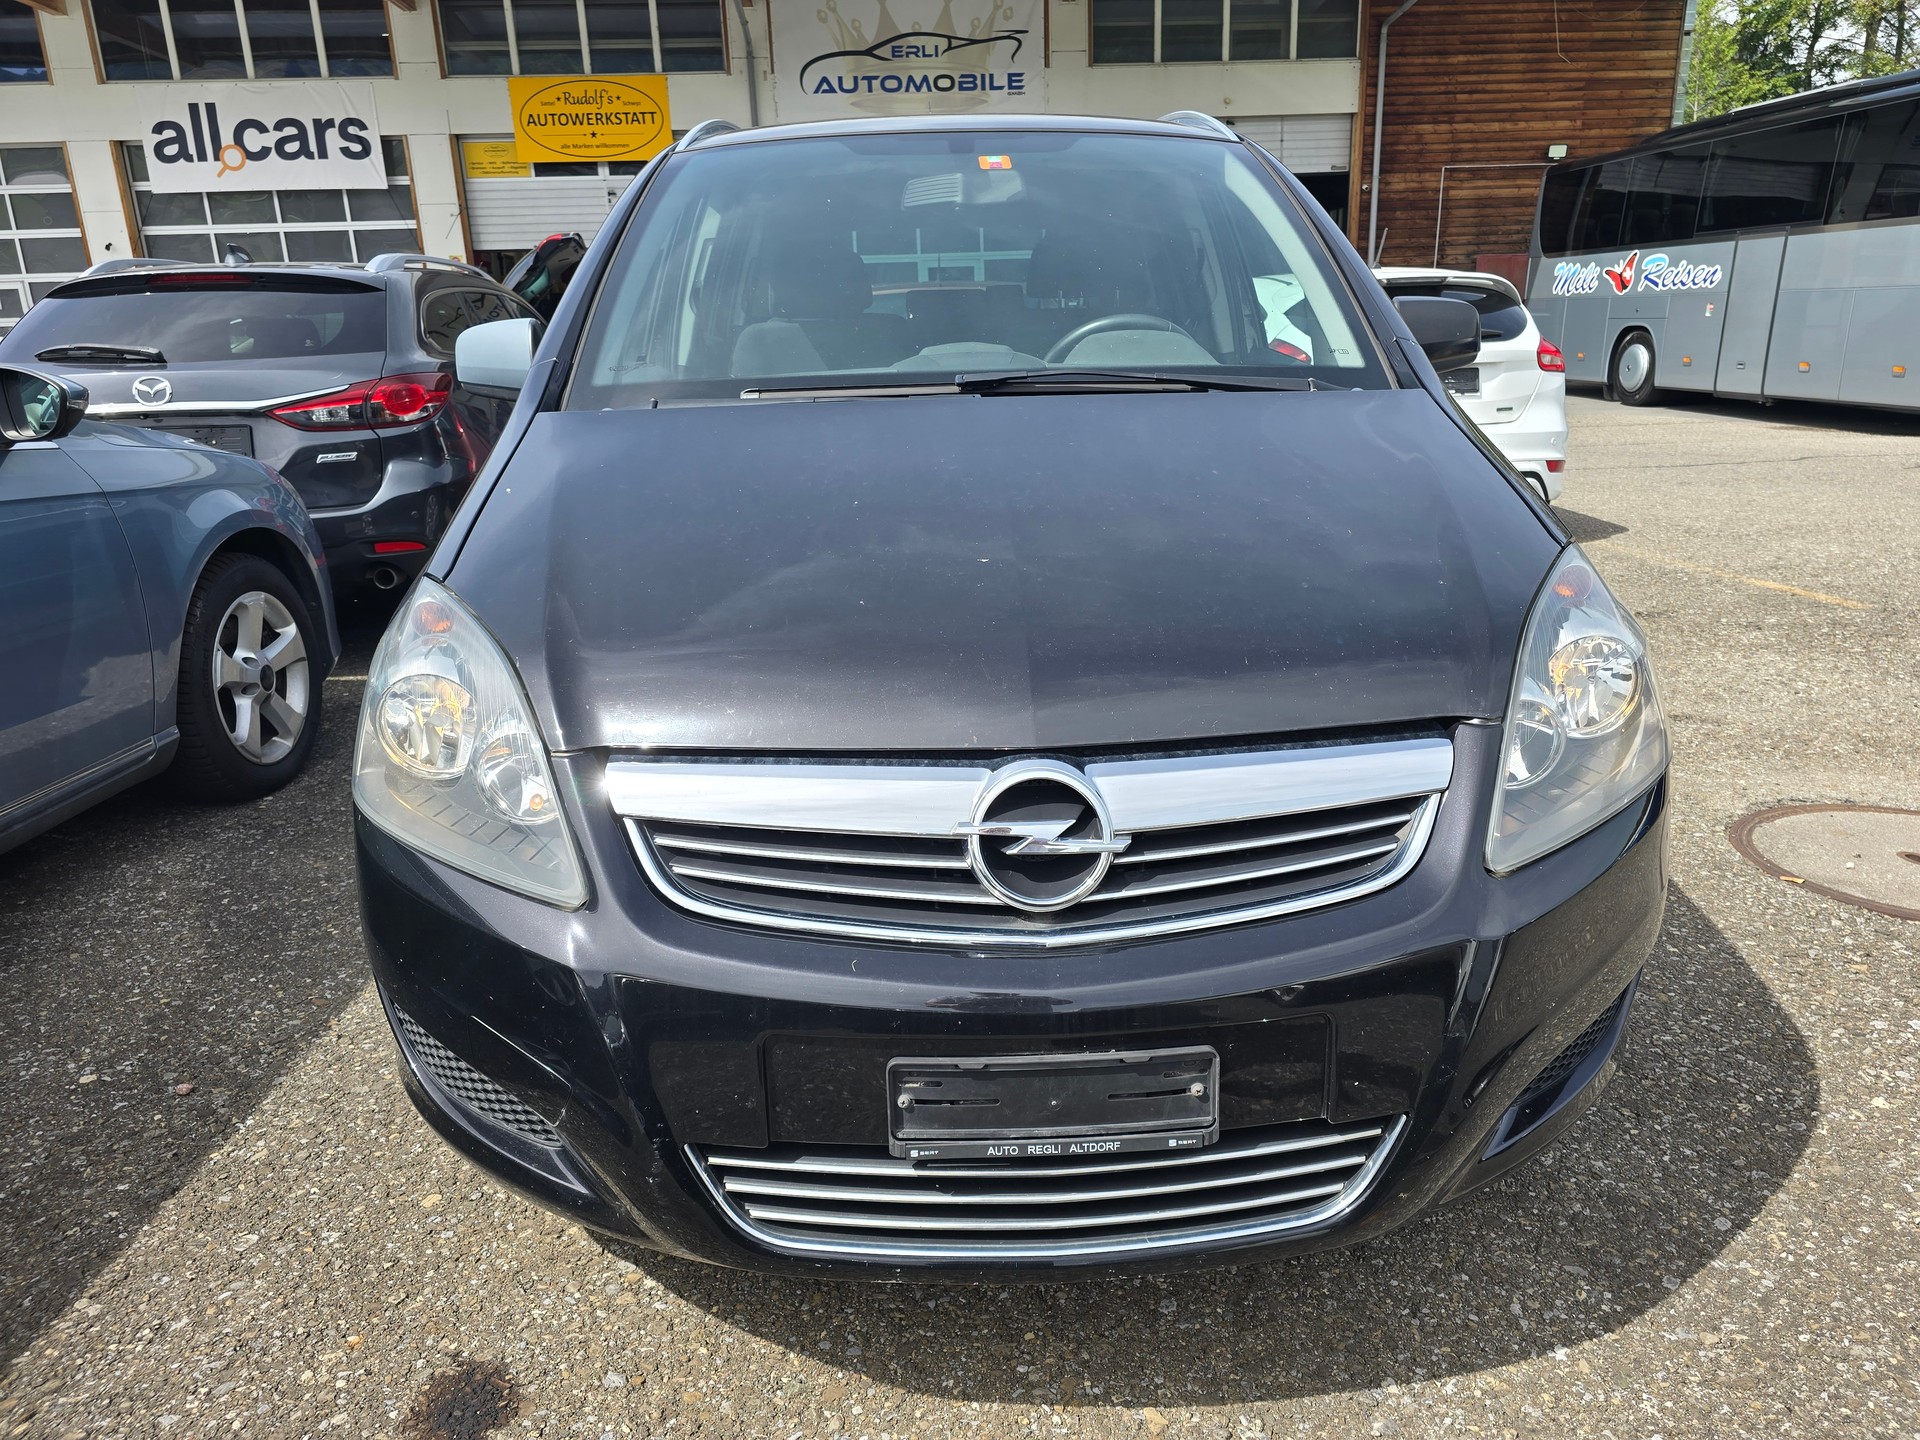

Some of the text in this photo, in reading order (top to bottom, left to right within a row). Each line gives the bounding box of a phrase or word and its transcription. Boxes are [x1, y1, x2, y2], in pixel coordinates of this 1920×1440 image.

[891, 45, 939, 58] ERLI
[813, 72, 1025, 94] AUTOMOBILE
[562, 89, 613, 109] Rudolf's
[527, 112, 657, 126] AUTOWERKSTATT
[1552, 253, 1722, 296] Mili Reisen
[987, 1146, 1019, 1156] AUTO
[1027, 1144, 1064, 1155] REGLI
[1069, 1141, 1121, 1153] ALTDORF
